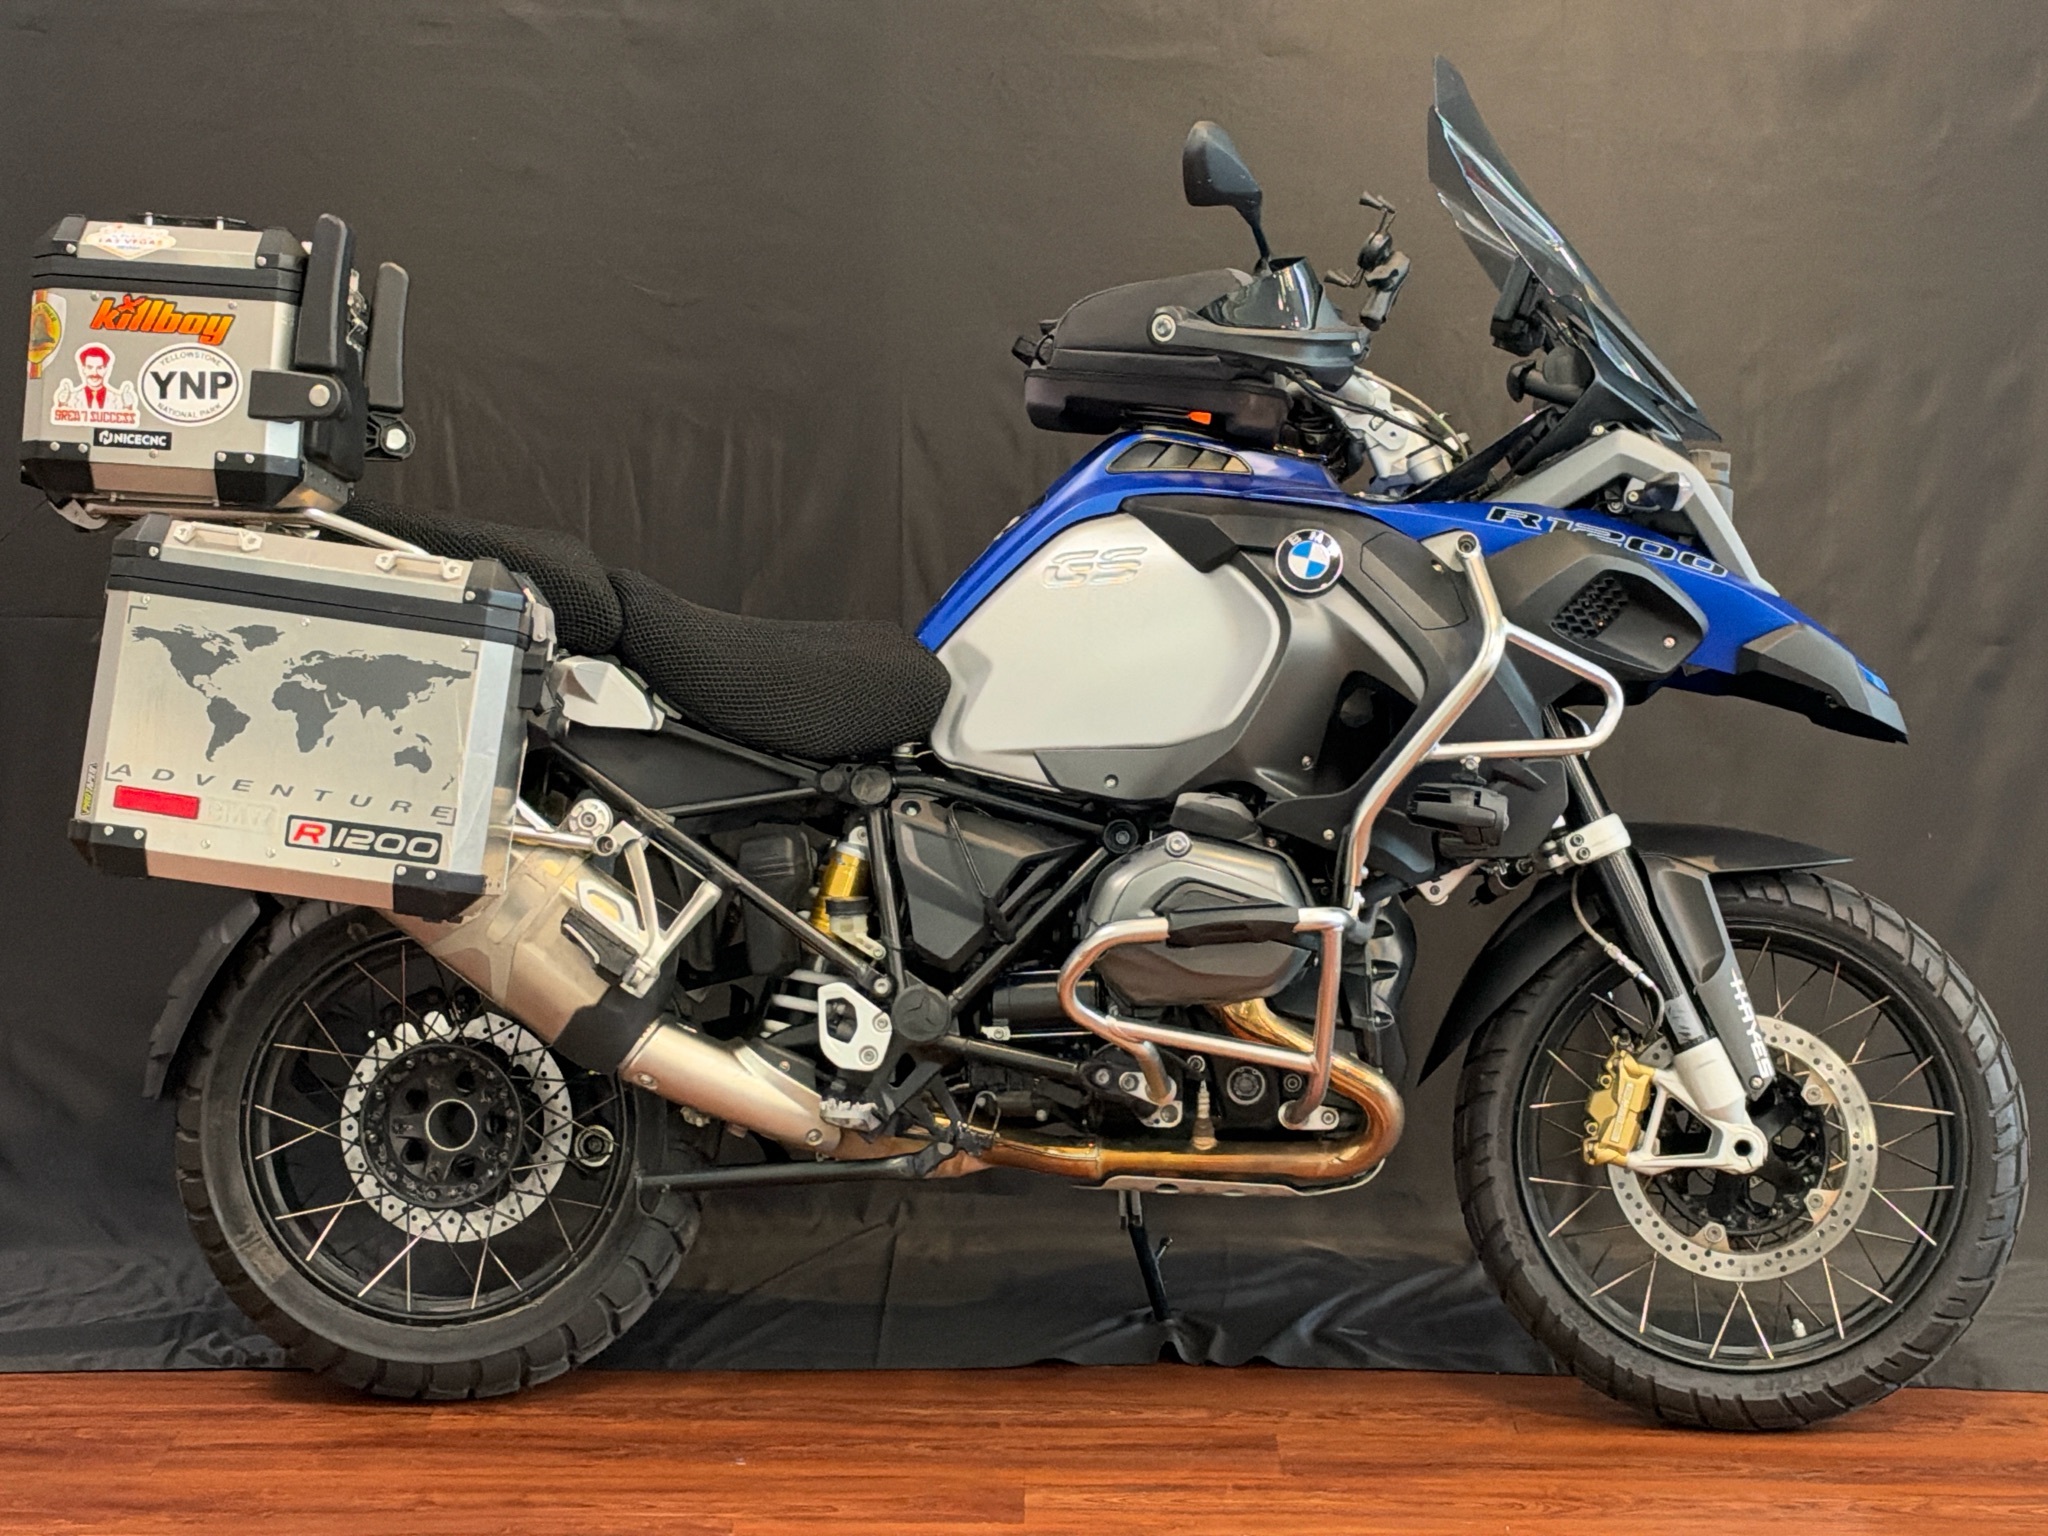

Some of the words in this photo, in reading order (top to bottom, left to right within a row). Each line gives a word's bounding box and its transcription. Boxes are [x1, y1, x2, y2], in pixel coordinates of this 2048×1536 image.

[160, 351, 222, 366] YELLOWSTONE
[150, 371, 233, 400] YNP
[89, 411, 137, 425] SUCCESS
[157, 402, 198, 418] NATIONAL
[200, 403, 221, 417] PARK
[114, 433, 167, 447] NICECNC
[1288, 530, 1340, 558] BMW
[1486, 505, 1729, 578] R1200
[1042, 547, 1147, 588] GS
[110, 763, 453, 819] ADVENTURE
[293, 822, 440, 859] R1200
[1730, 967, 1777, 1079] HAYES
